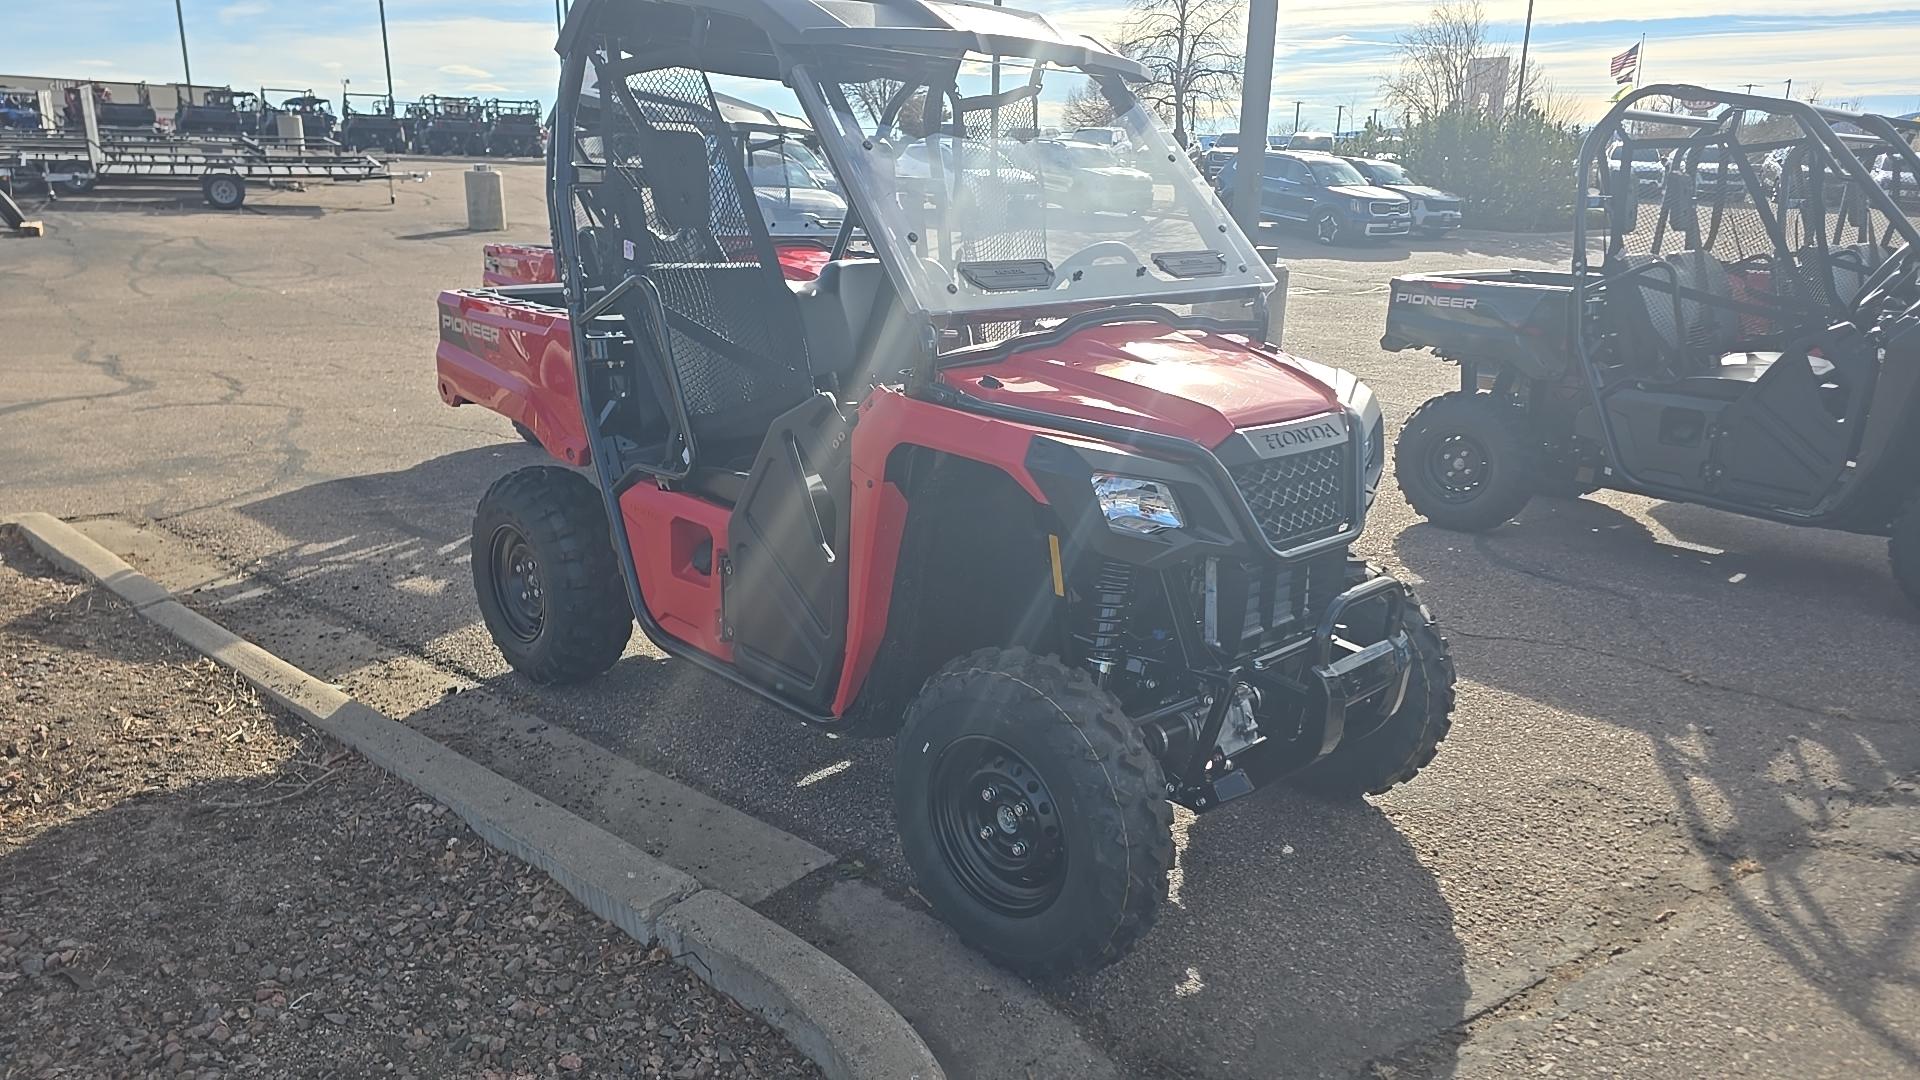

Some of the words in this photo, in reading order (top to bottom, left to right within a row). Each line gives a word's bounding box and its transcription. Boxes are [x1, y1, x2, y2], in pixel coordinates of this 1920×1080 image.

[1396, 293, 1477, 309] PIONEER
[442, 314, 500, 344] PIONEER
[1260, 423, 1340, 449] HONDA
